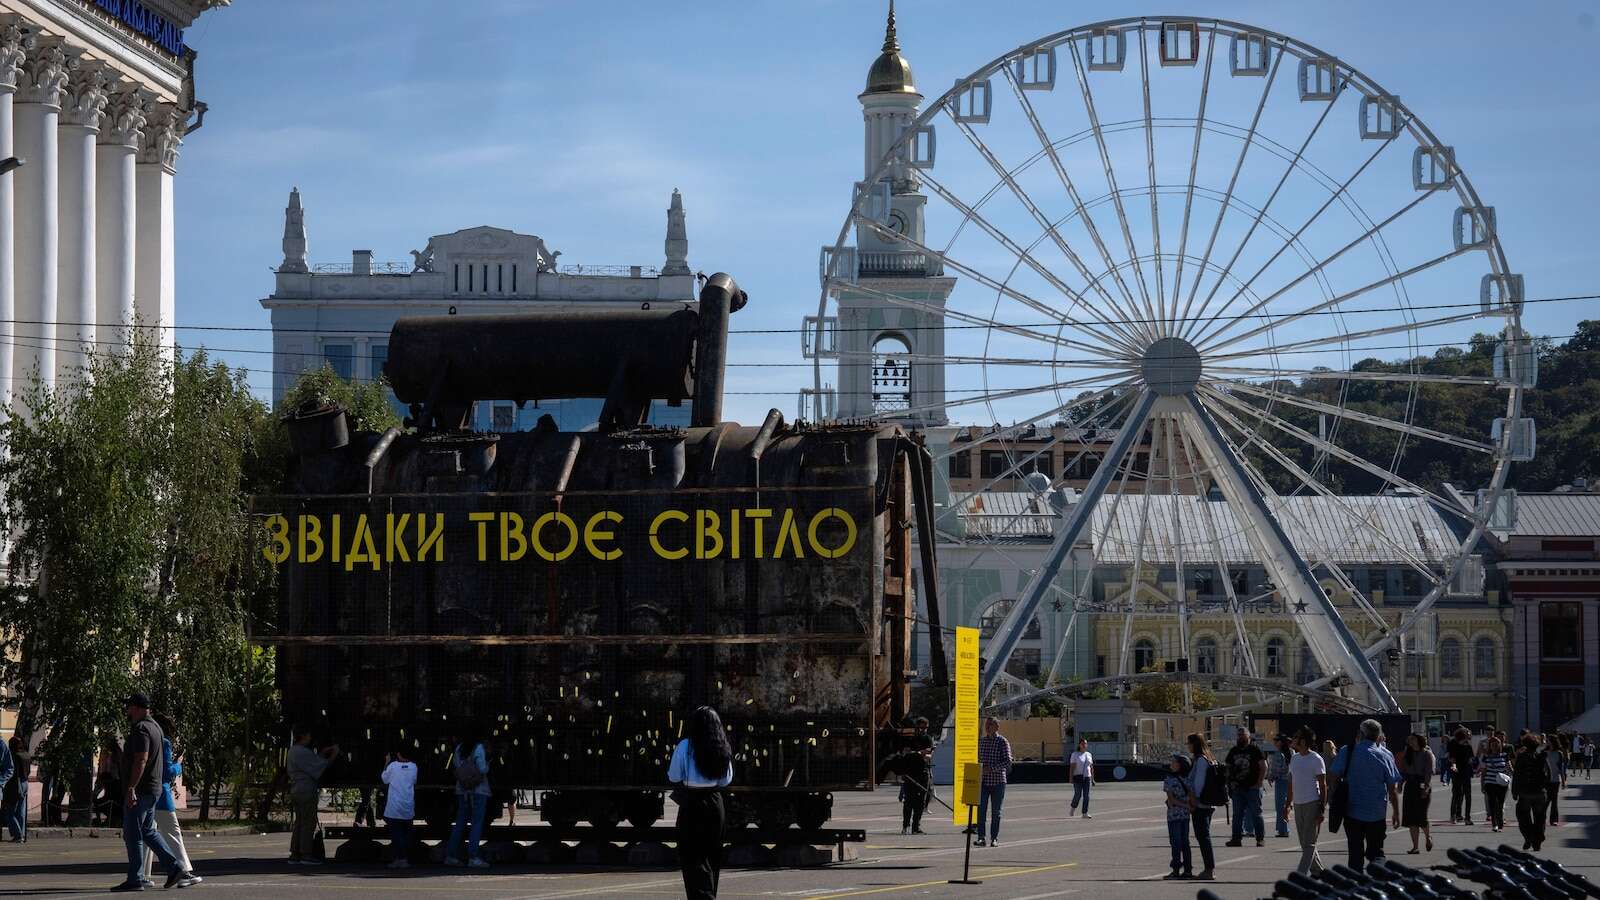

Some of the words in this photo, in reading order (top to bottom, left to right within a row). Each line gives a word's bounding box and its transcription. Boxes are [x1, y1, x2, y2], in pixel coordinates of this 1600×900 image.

[262, 513, 444, 571] ЗВІДКИ
[469, 511, 622, 560] ТВОЄ
[649, 508, 857, 559] СВІТЛО
